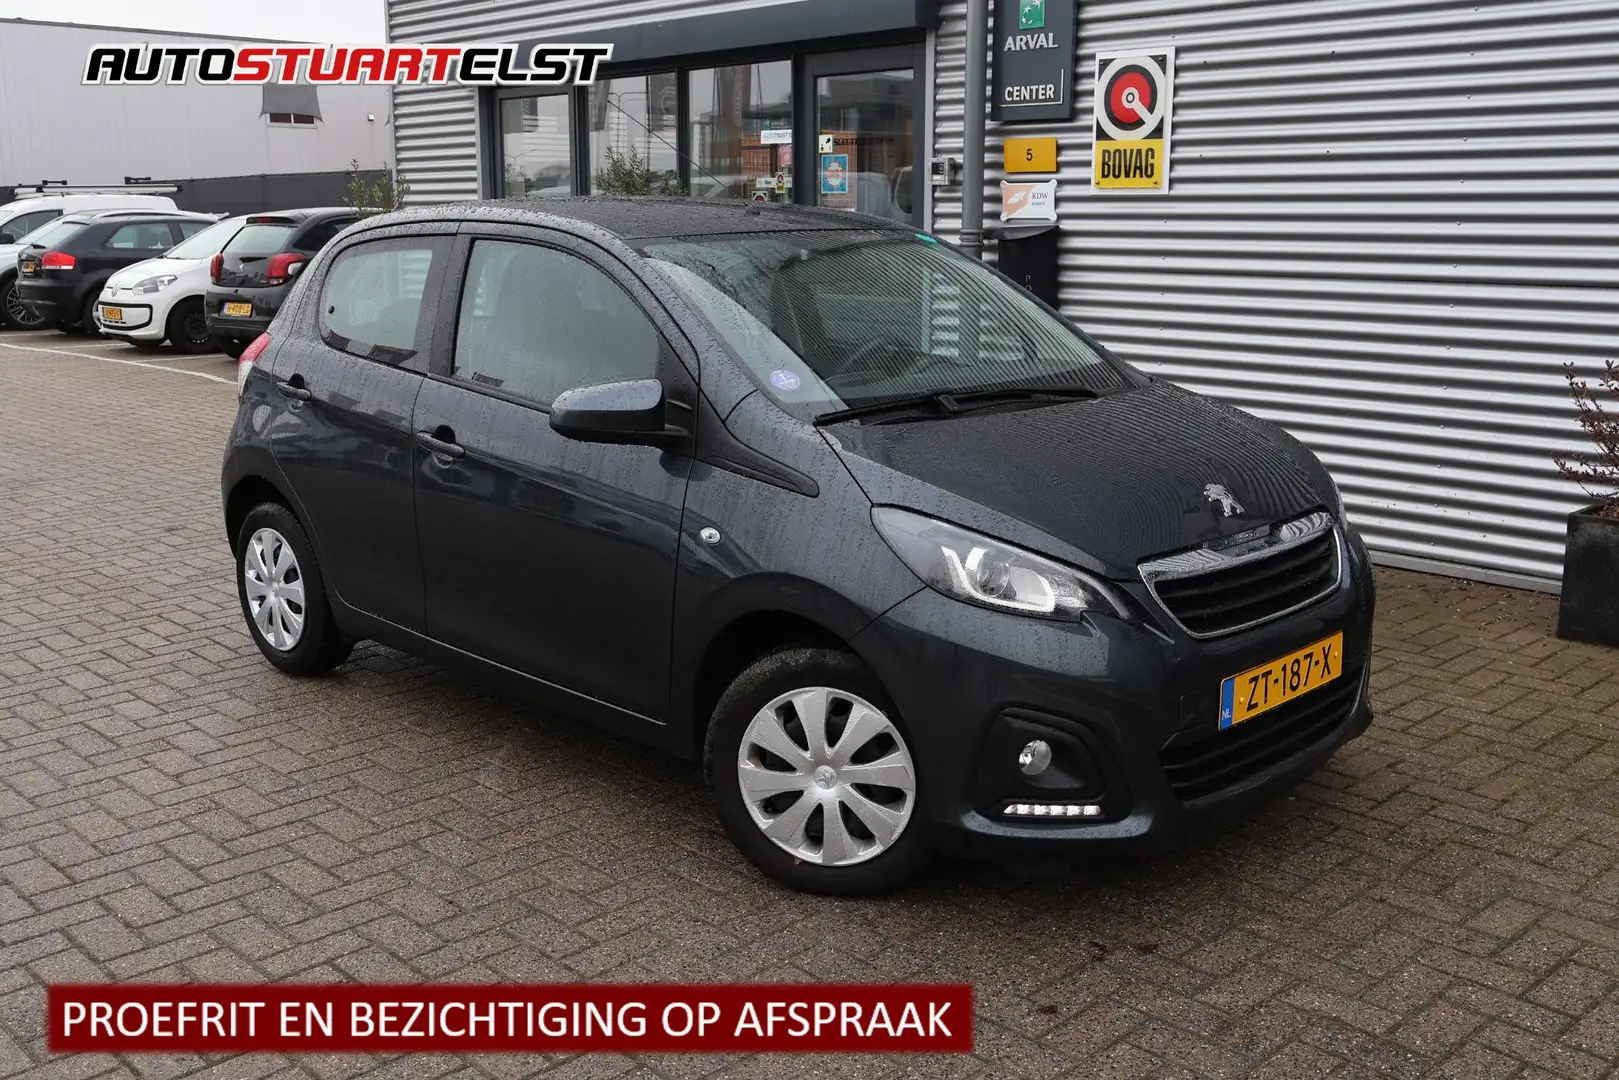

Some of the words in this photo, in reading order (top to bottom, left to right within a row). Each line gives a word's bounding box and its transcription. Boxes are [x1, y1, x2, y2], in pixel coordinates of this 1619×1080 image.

[1003, 32, 1059, 52] ARVAL
[1004, 84, 1055, 102] CENTER
[1025, 148, 1033, 162] 5
[1101, 147, 1155, 179] BOVAG
[1246, 643, 1332, 712] ZT-187-X
[1221, 708, 1231, 721] NL
